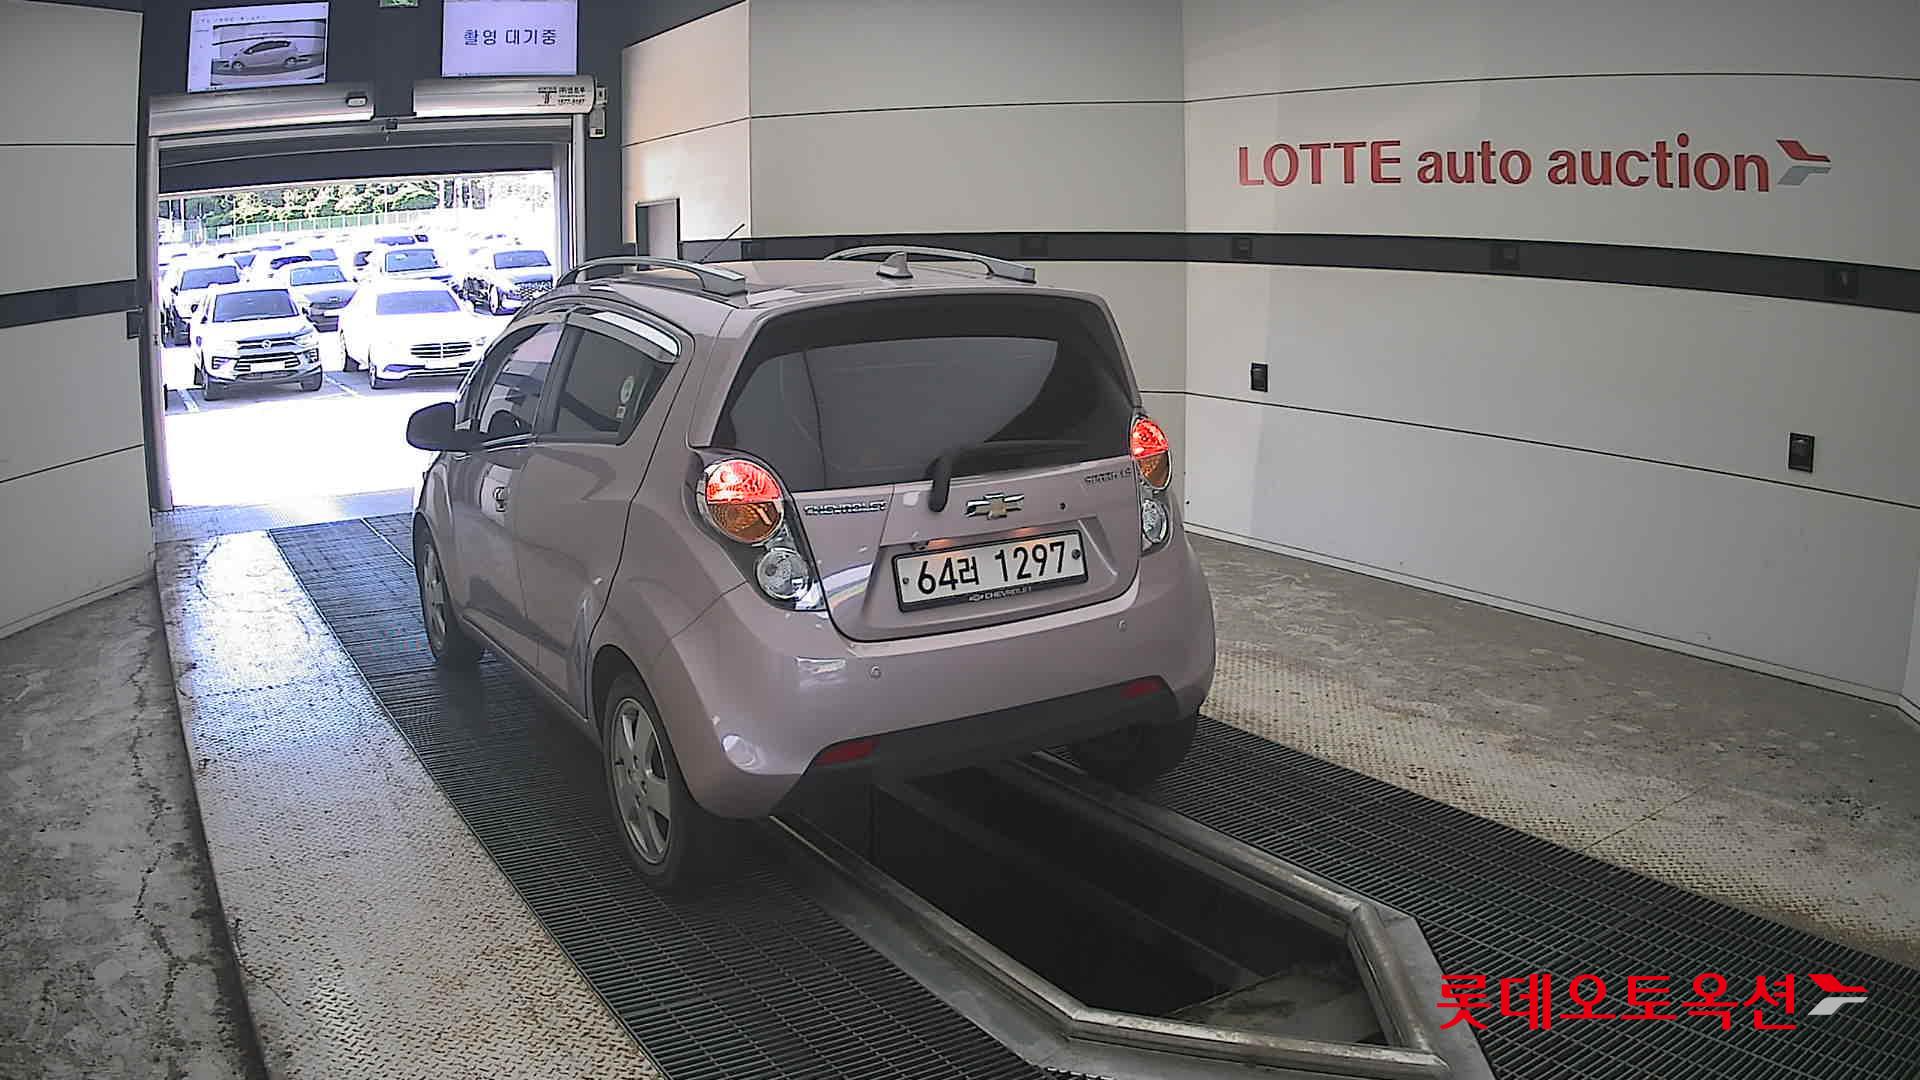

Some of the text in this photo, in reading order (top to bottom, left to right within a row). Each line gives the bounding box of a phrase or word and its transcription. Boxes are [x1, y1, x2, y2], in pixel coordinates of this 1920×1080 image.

[463, 29, 556, 46] 촬영 대기중
[1238, 133, 1770, 193] LOTTE auto auction
[917, 541, 1066, 595] 64러 1297
